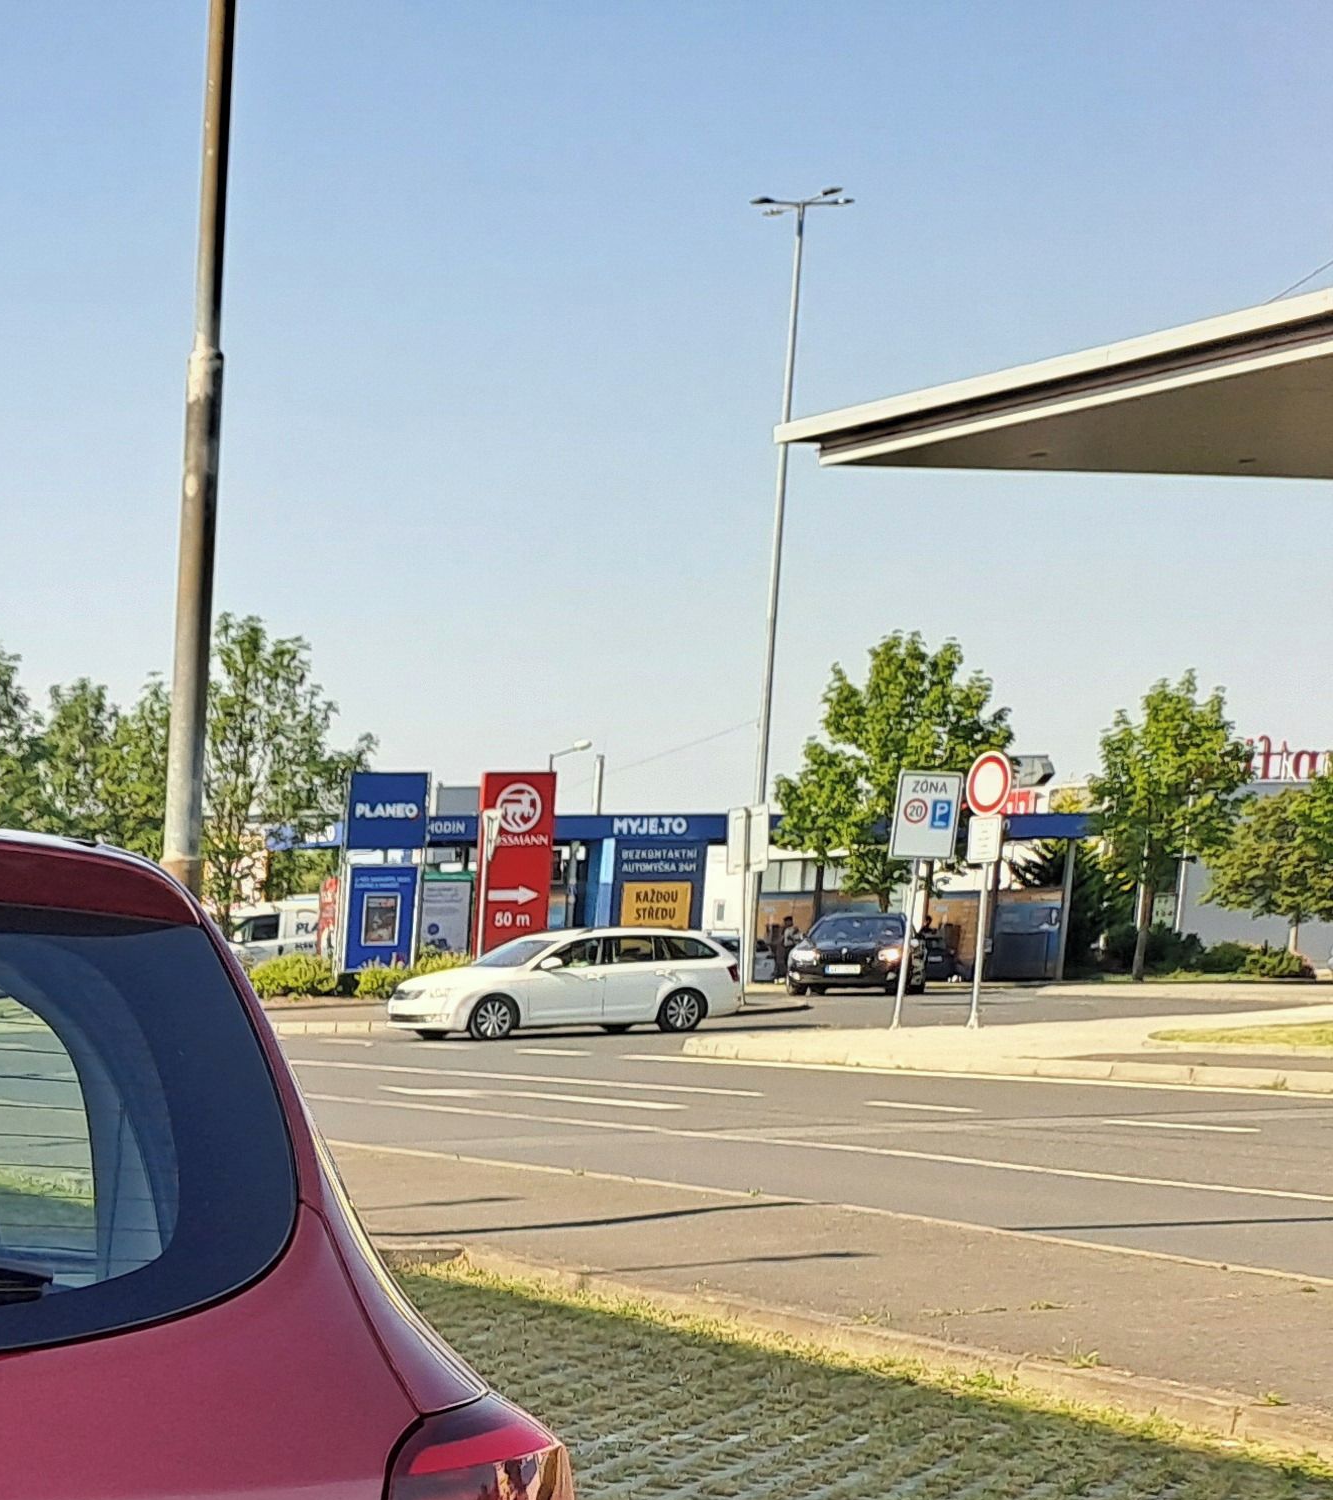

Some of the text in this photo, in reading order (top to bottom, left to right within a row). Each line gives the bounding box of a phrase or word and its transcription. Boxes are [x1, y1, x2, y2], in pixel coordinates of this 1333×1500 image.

[355, 802, 419, 819] PLANEO
[908, 805, 923, 817] 20
[613, 816, 688, 835] MYJE.TO
[635, 888, 679, 904] KAŽDOU
[515, 913, 531, 928] m
[634, 904, 677, 921] STŘEDU
